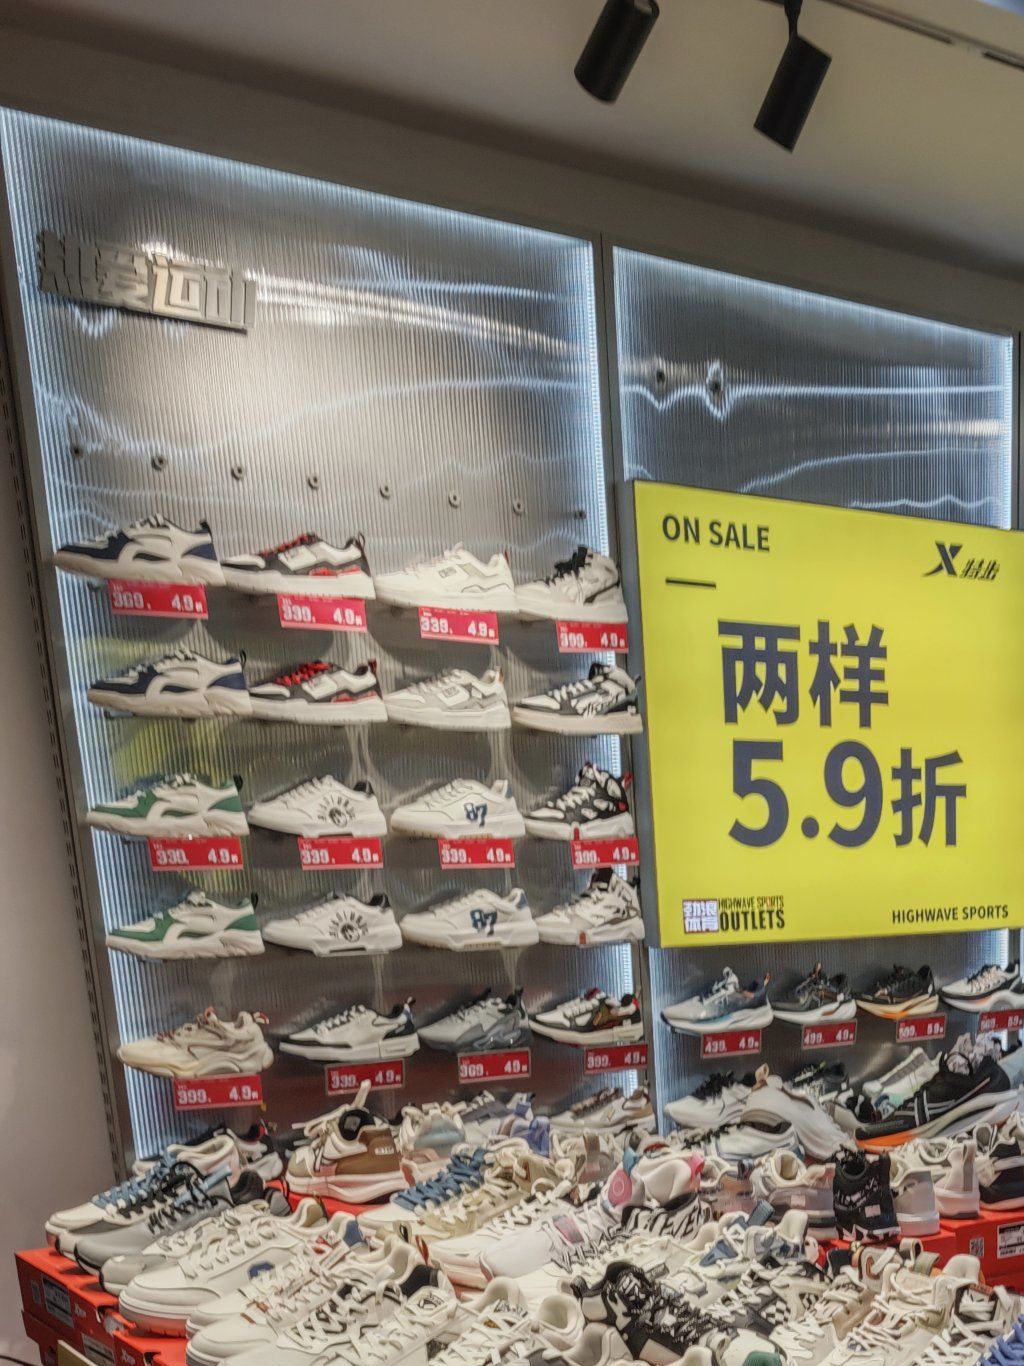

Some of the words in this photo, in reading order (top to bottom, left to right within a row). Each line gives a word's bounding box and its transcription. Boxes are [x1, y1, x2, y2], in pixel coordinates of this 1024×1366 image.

[662, 514, 700, 544] ON
[708, 522, 770, 552] SALE
[716, 618, 890, 729] 两样
[728, 738, 967, 849] 5.9折
[719, 909, 785, 932] OUTLETS
[891, 907, 959, 925] HIGHWAVE
[961, 905, 1009, 922] SPORTS
